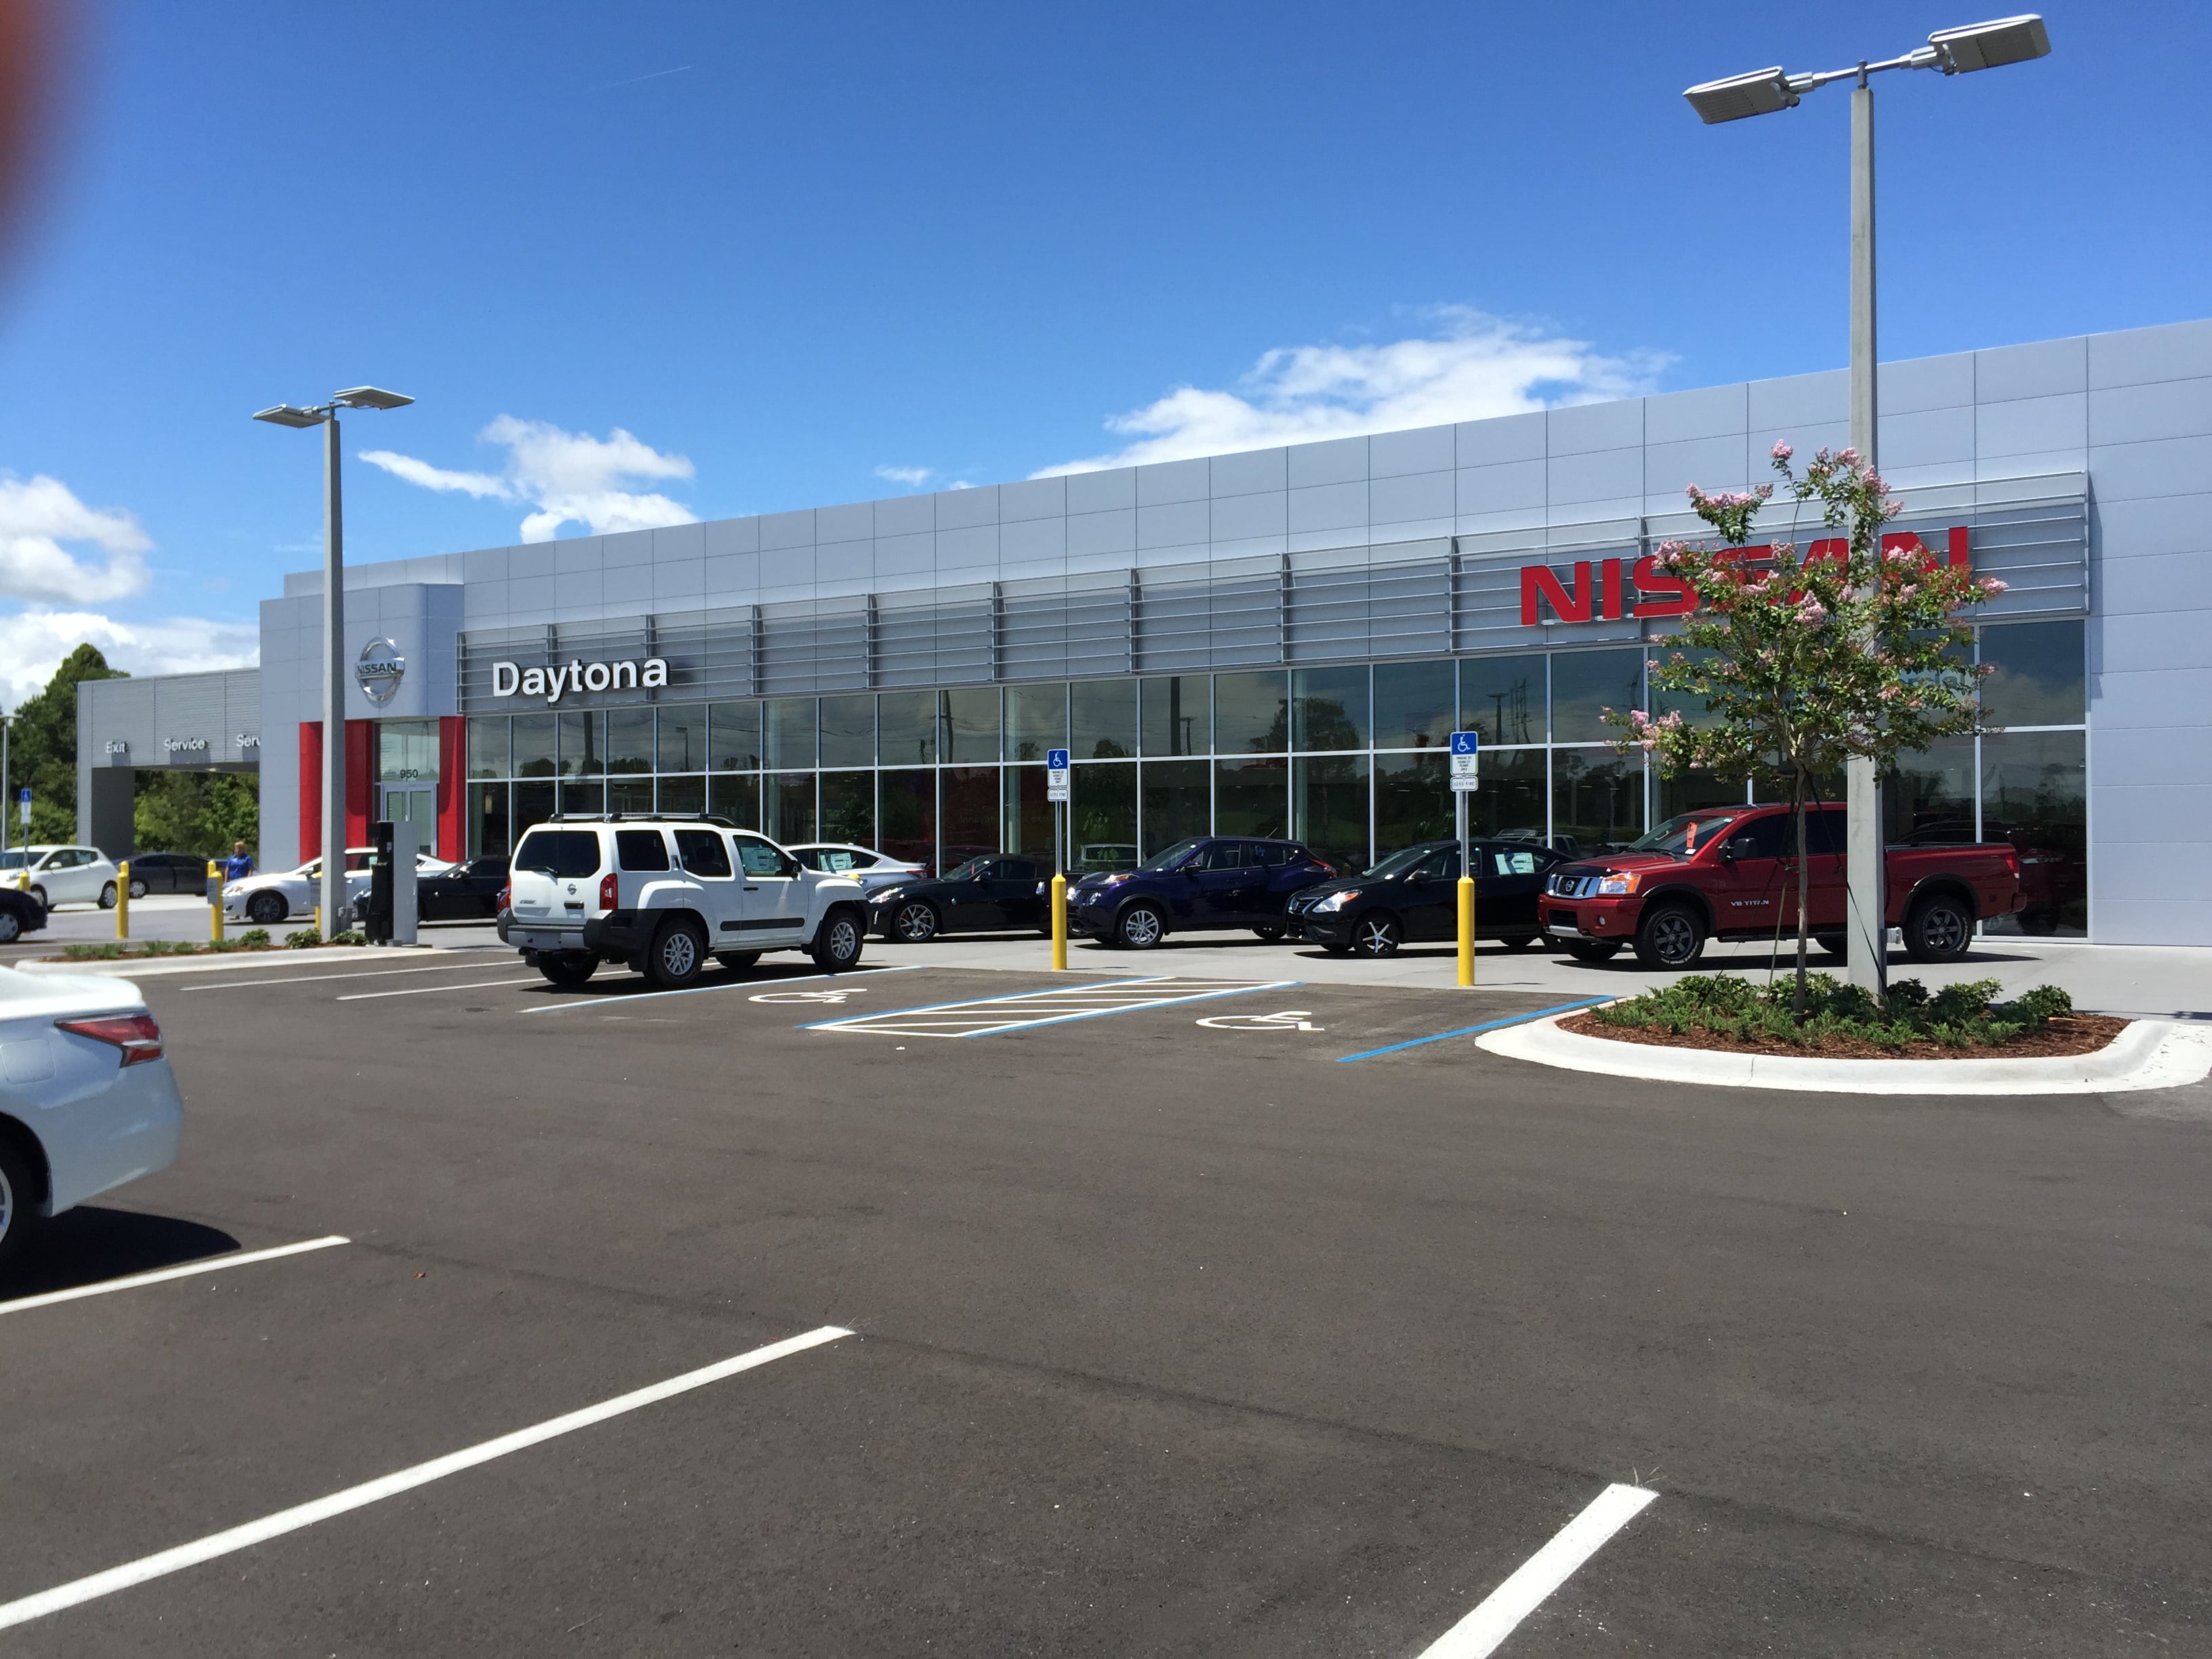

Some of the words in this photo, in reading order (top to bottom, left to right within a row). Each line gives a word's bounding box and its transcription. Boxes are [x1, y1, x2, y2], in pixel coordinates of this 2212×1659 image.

[357, 662, 396, 674] NISSAN
[493, 658, 668, 703] Daytona
[106, 740, 126, 754] Exit
[163, 737, 206, 752] Service
[400, 769, 418, 779] 950
